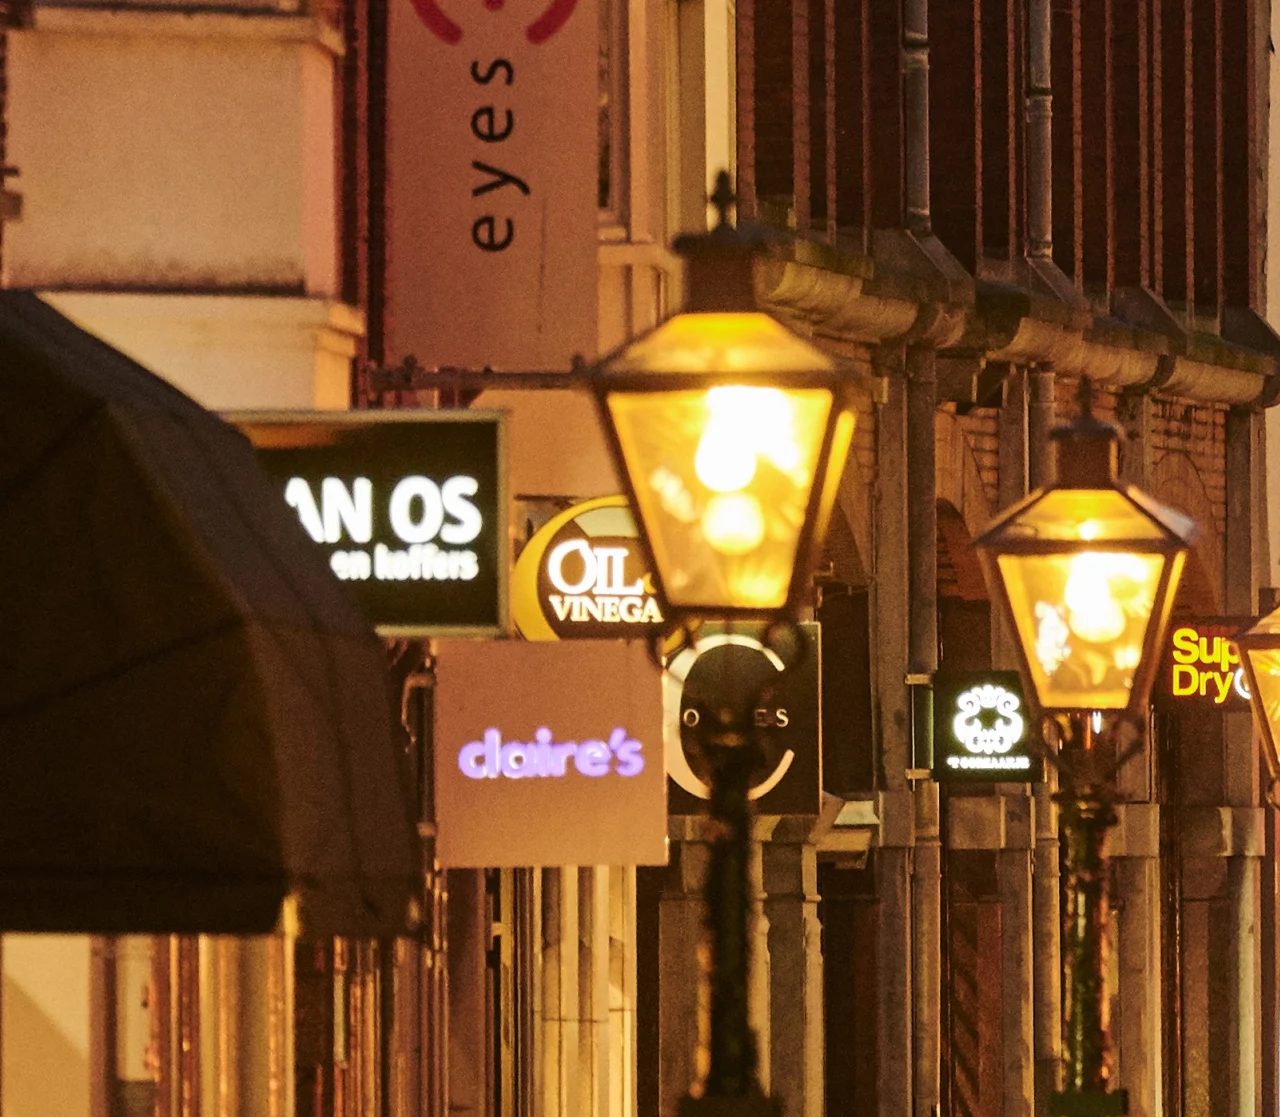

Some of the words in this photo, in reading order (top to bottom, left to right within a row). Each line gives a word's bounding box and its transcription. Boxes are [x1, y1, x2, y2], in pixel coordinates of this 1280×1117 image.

[470, 58, 531, 252] eyes
[388, 474, 483, 545] OS
[548, 538, 645, 596] OIL
[457, 726, 646, 780] claire's
